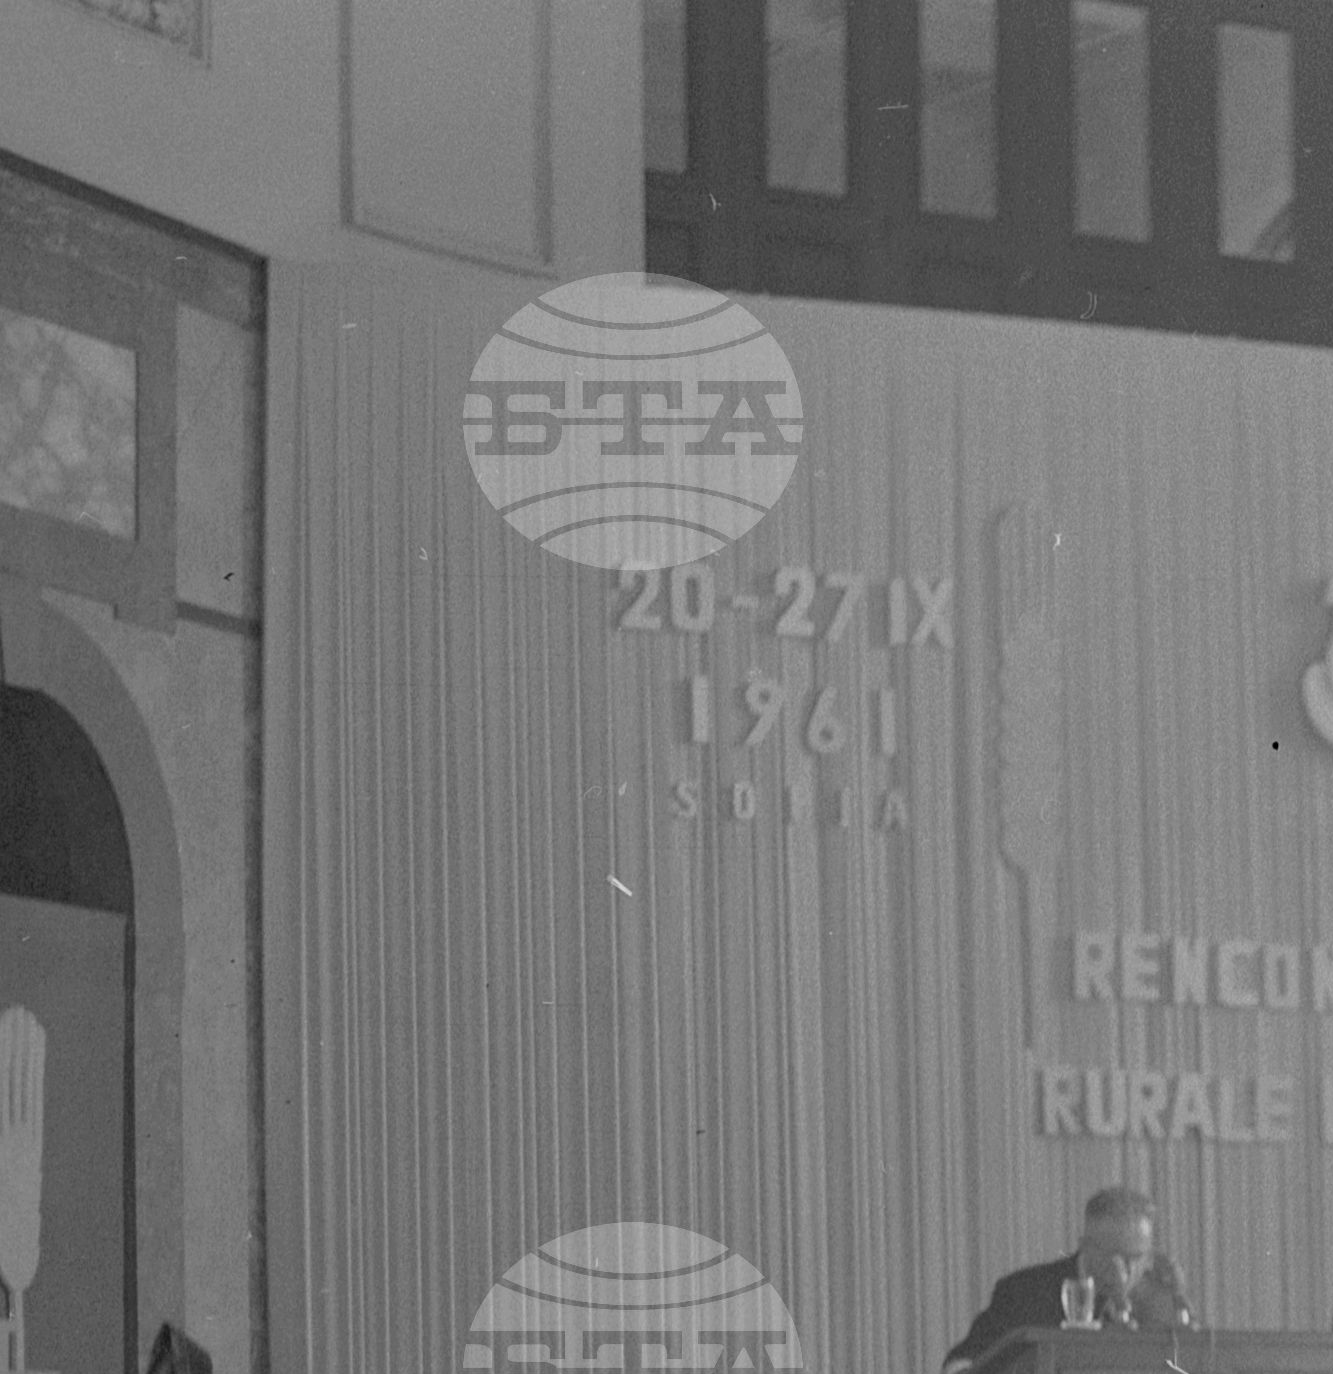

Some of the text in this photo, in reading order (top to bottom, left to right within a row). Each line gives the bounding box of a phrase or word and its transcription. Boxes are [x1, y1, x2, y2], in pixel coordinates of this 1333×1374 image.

[620, 561, 867, 643] 20-27
[692, 673, 896, 757] 1961
[1041, 1066, 1294, 1143] RURALE
